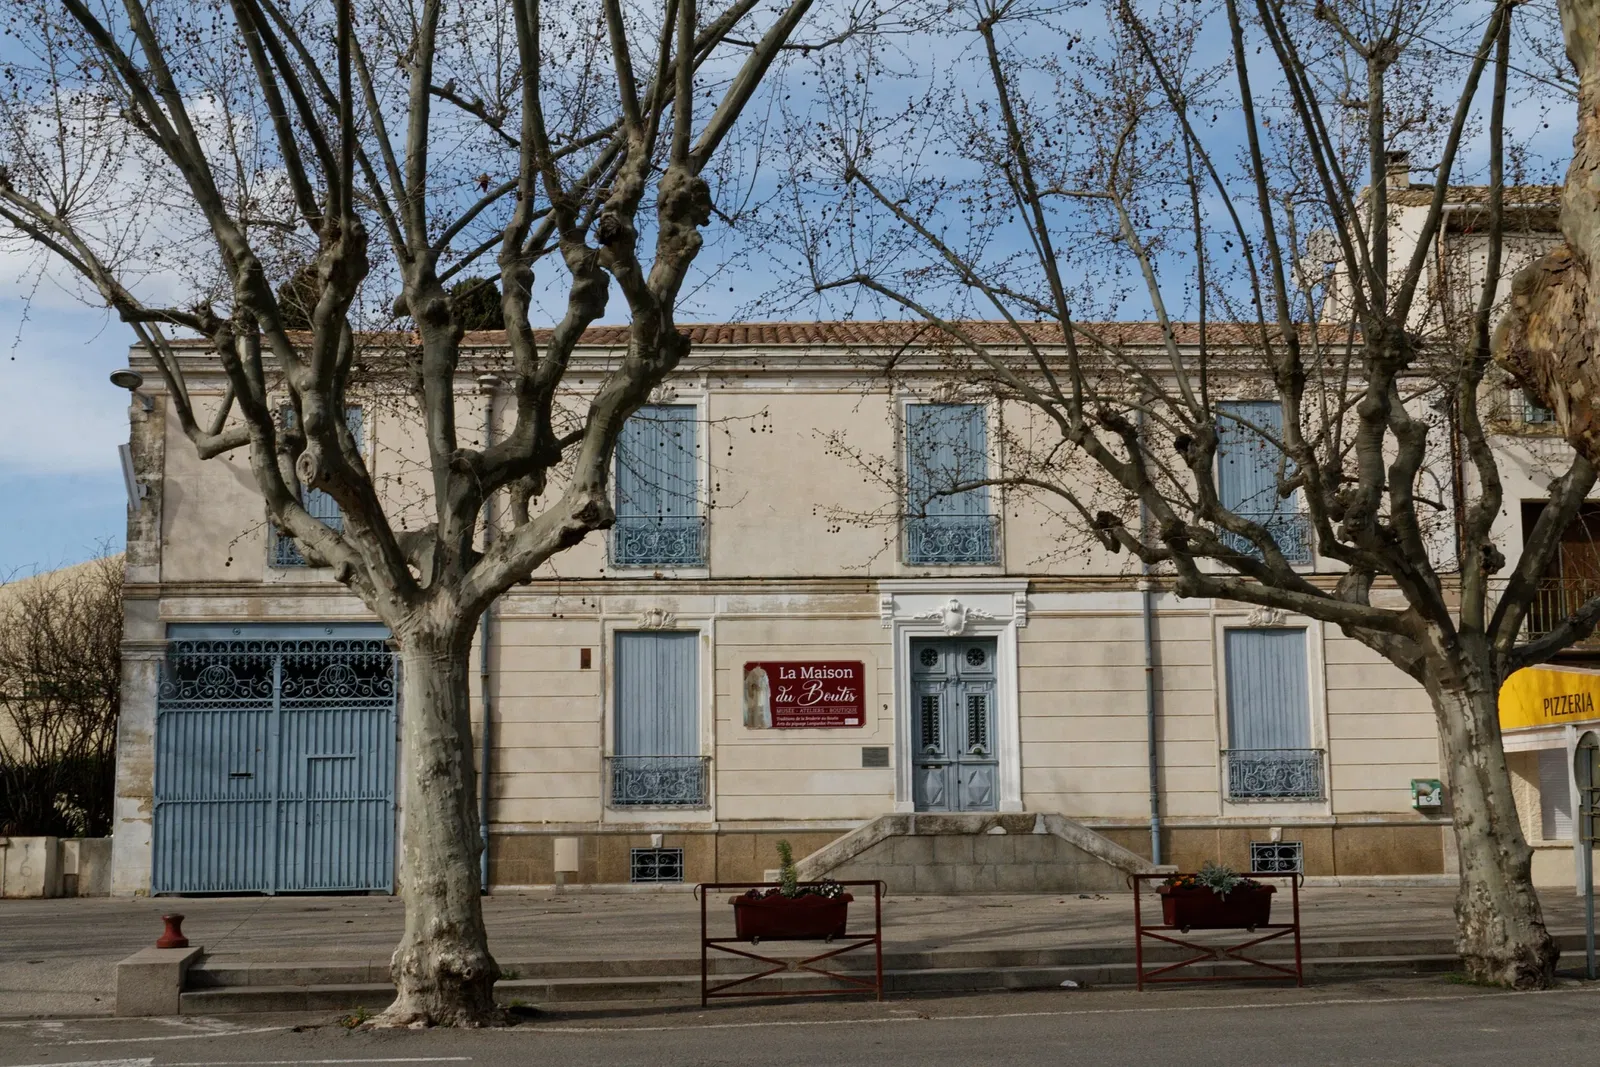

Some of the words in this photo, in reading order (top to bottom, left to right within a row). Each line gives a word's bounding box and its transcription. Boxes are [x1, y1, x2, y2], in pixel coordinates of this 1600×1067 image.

[780, 667, 796, 679] La
[800, 665, 854, 679] Maison
[776, 685, 796, 702] du
[797, 680, 858, 706] Boutis
[1543, 692, 1594, 717] PIZZERIA
